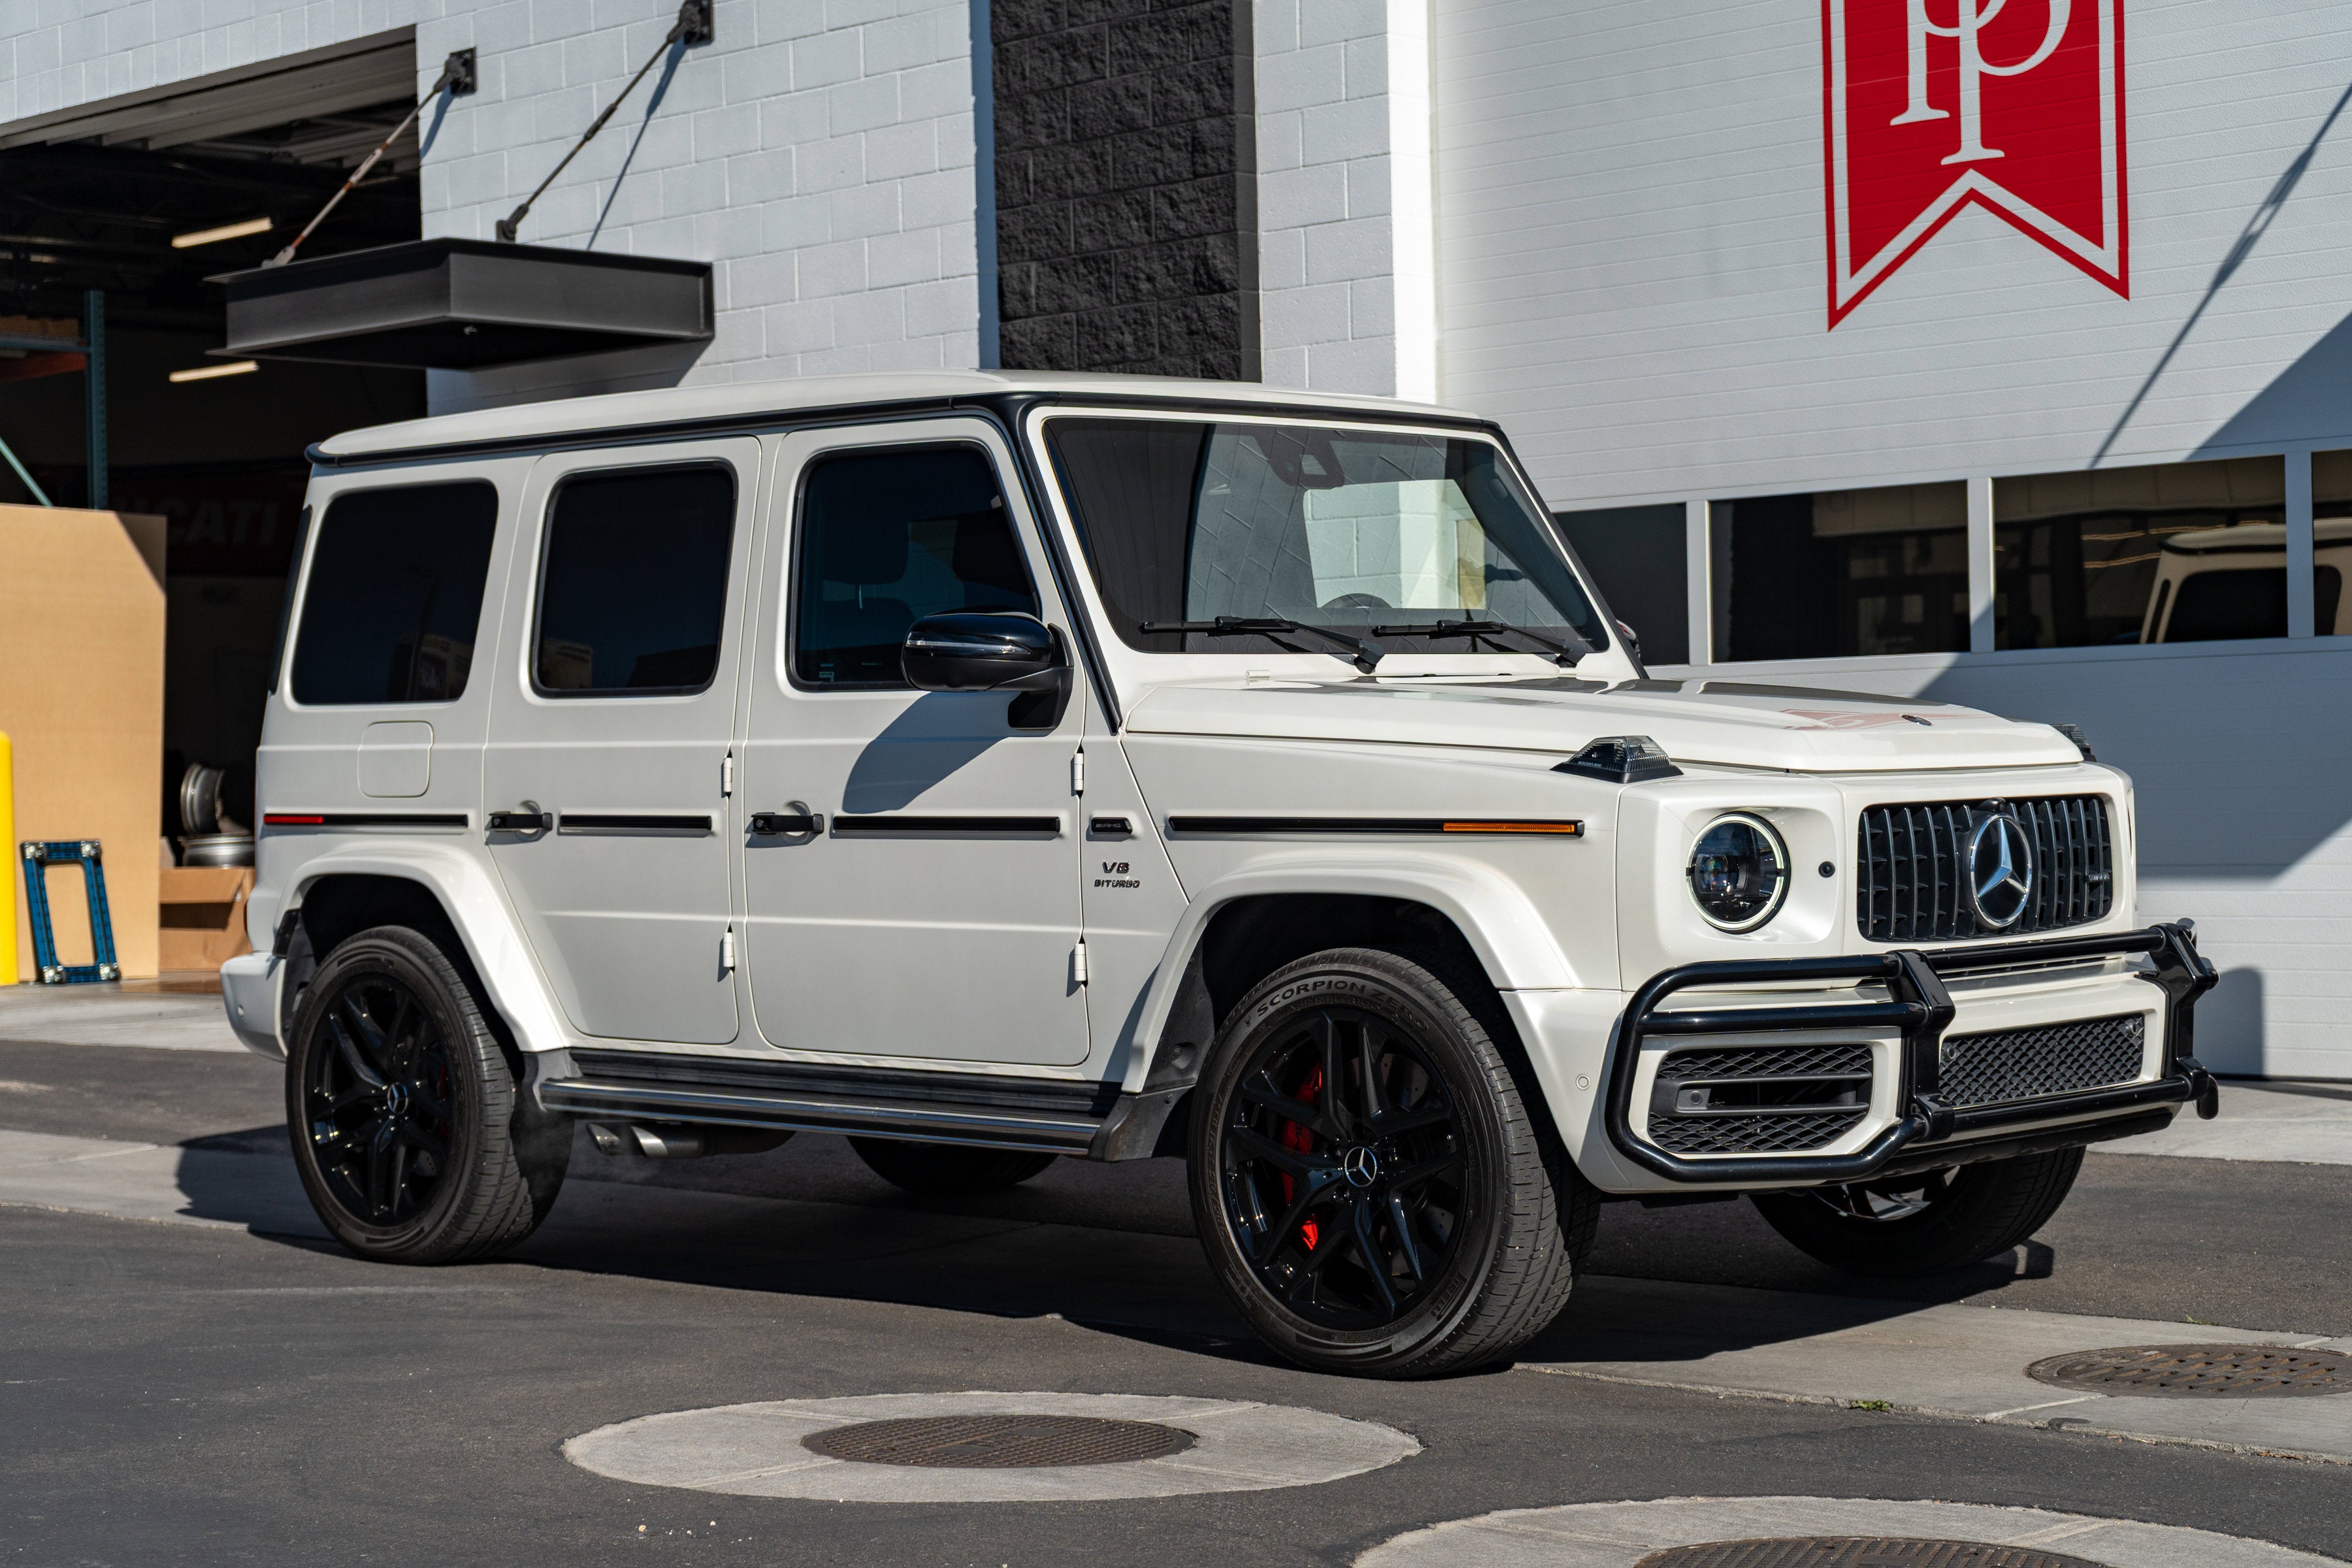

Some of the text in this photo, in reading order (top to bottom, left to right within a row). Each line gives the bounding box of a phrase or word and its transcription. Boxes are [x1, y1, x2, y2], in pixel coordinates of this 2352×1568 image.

[1102, 861, 1130, 874] V8
[1094, 879, 1141, 889] BITURBO
[1256, 979, 1430, 1031] SCORPION ZERO
